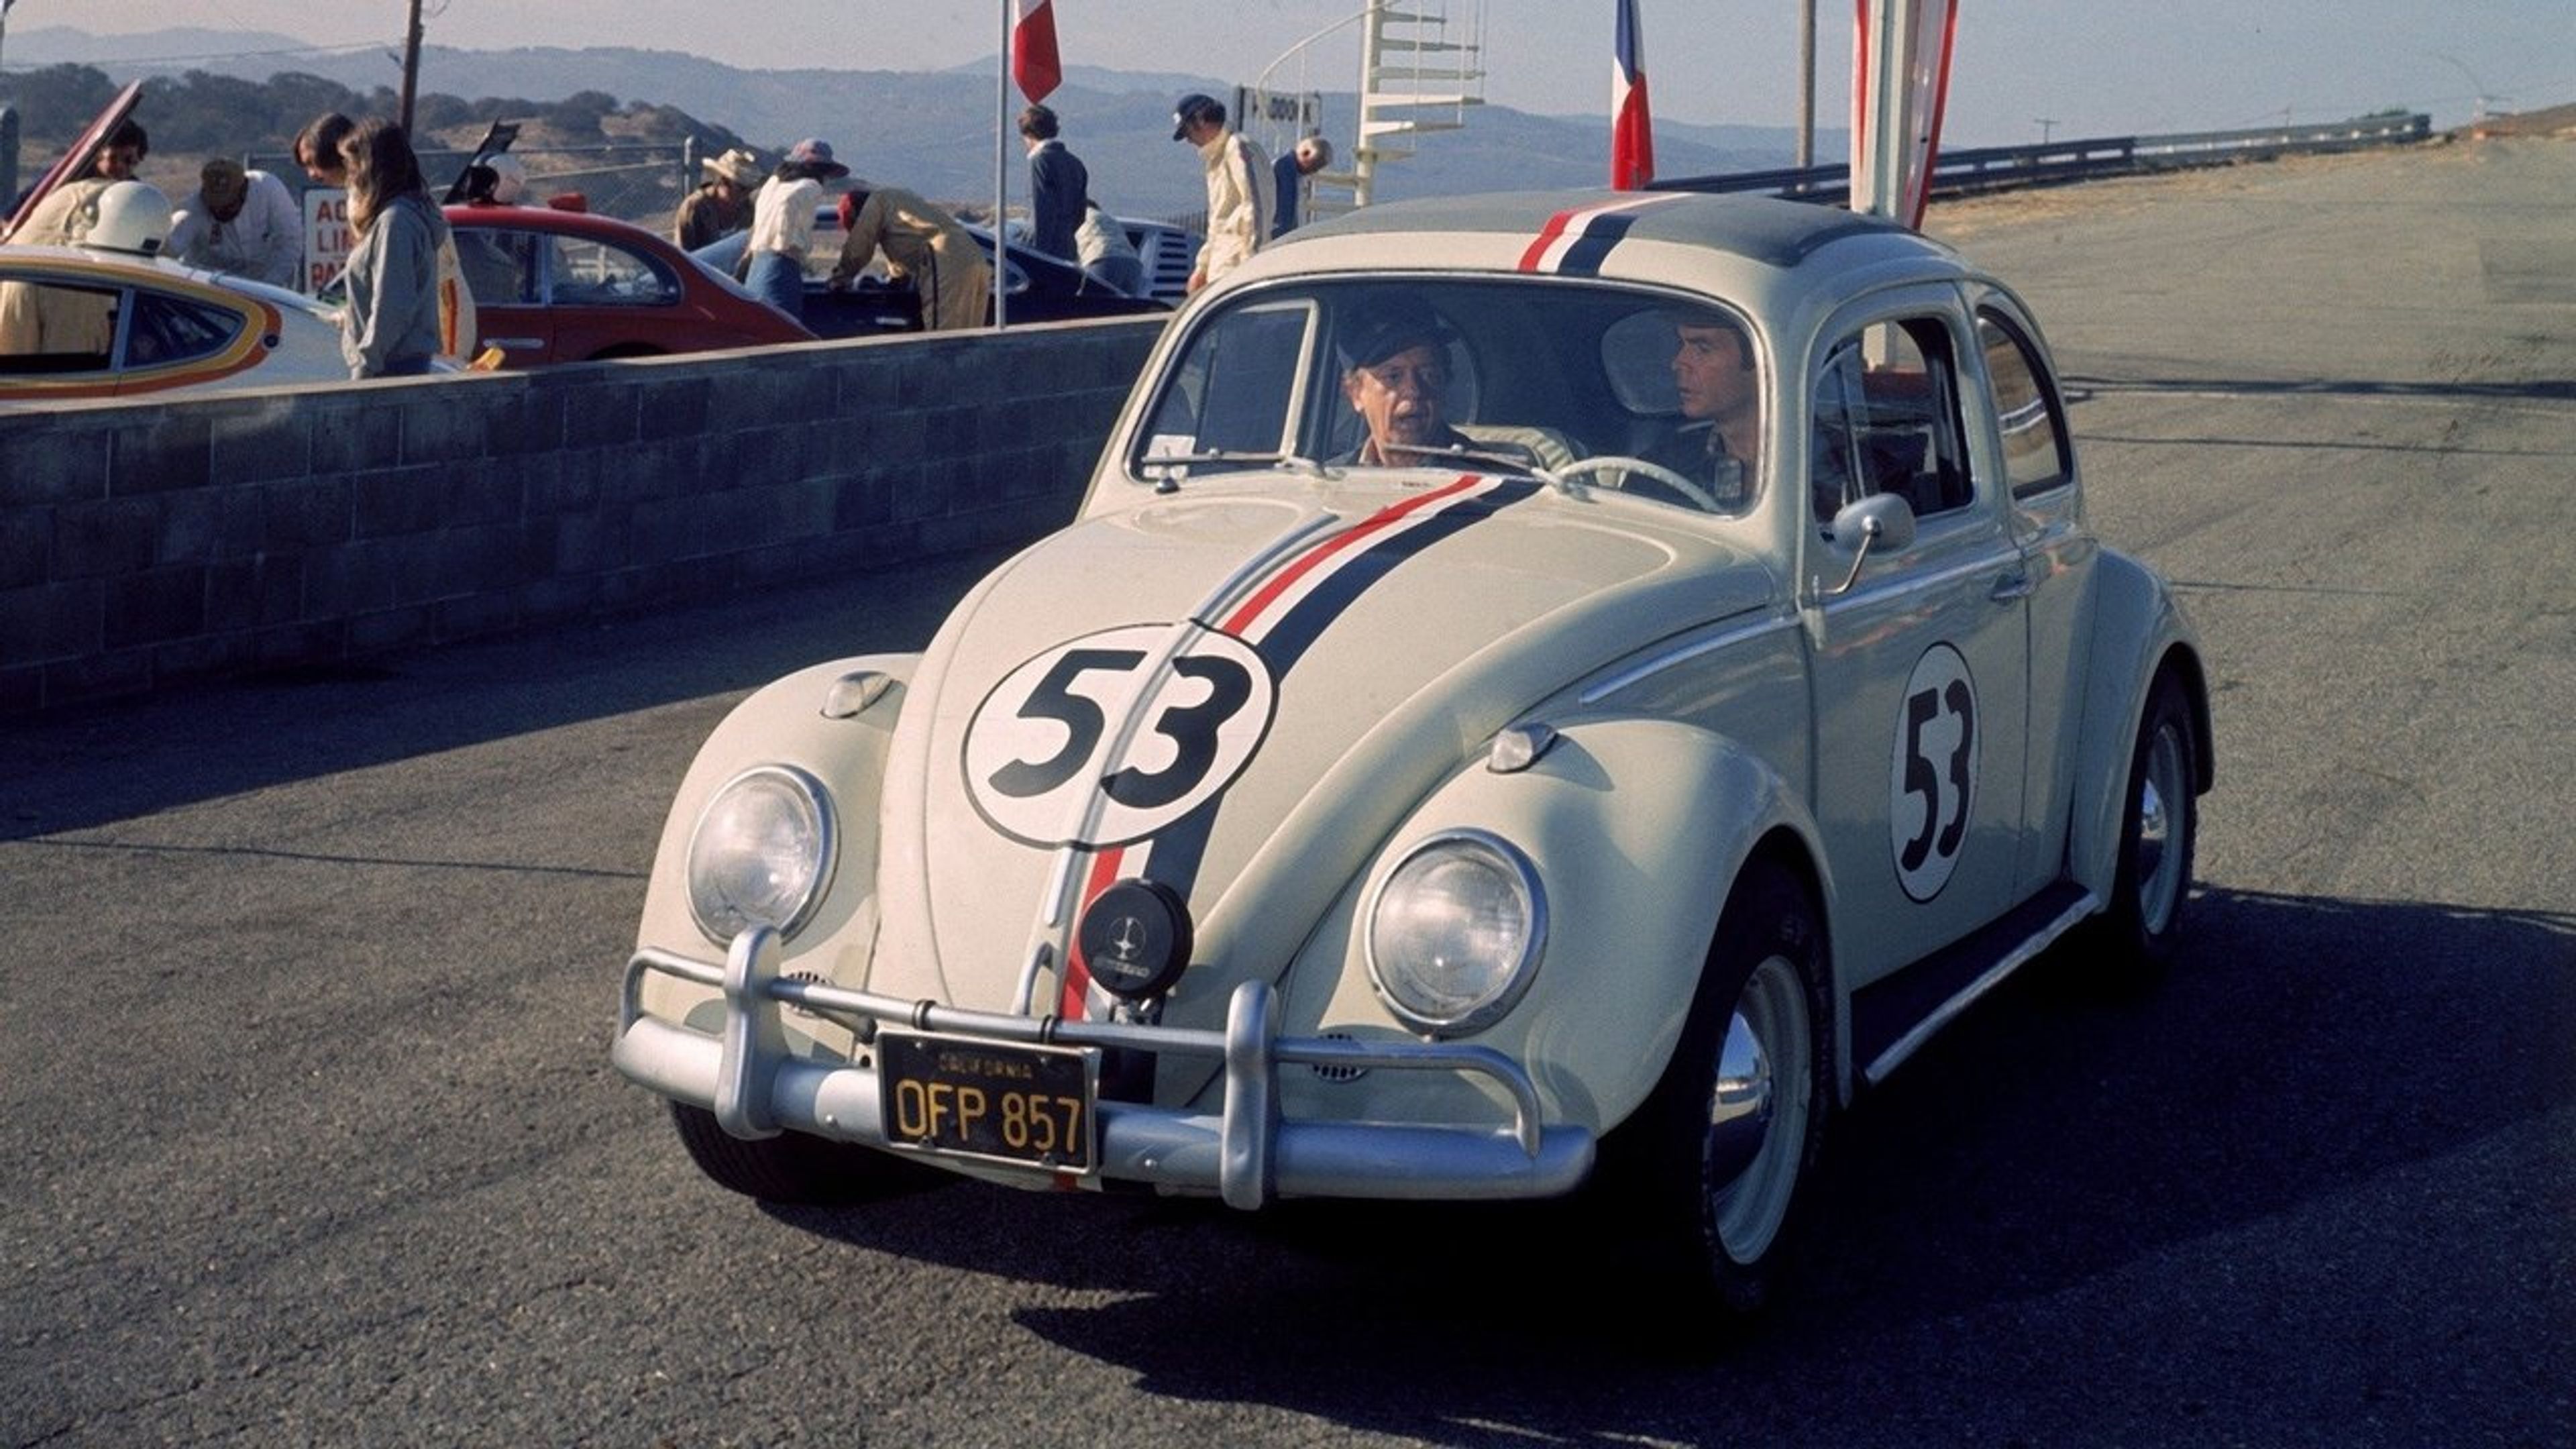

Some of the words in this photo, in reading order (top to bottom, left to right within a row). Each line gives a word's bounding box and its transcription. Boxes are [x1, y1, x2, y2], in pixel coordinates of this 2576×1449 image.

[988, 649, 1252, 809] 53
[1900, 679, 1974, 872] 53
[896, 1078, 986, 1140] OFP
[1002, 1092, 1081, 1153] 857
[940, 1053, 1032, 1079] CALIFORNIA
